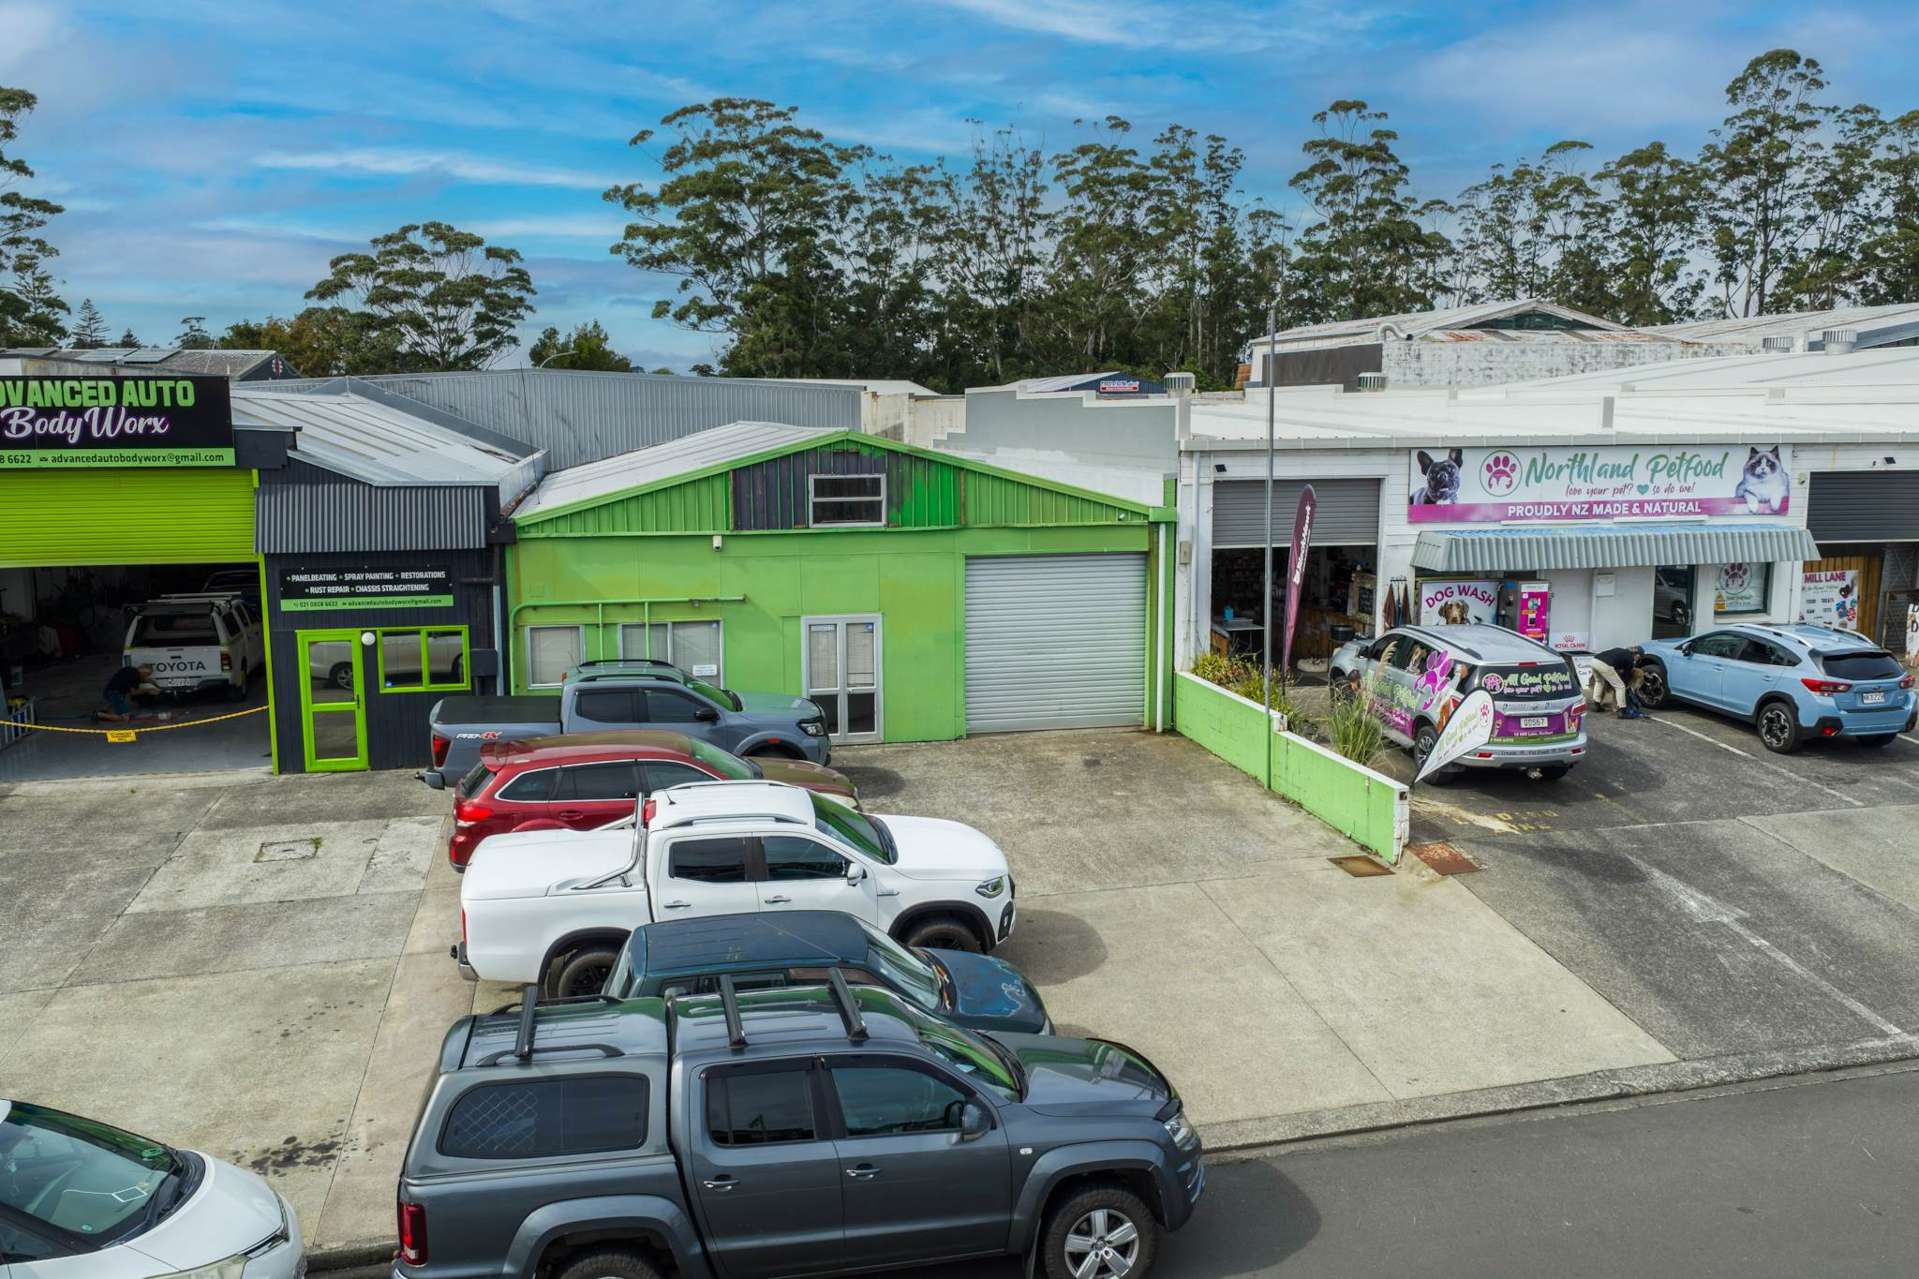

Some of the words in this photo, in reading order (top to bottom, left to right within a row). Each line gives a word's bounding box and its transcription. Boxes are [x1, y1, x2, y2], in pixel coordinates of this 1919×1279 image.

[122, 380, 196, 407] AUTO
[7, 454, 32, 464] 6622
[51, 452, 224, 464] advancedautobodyworx@gmail.com
[1524, 451, 1639, 489] Northland
[1565, 484, 1583, 497] love
[1586, 486, 1608, 498] your
[1612, 483, 1634, 497] pet?
[1664, 482, 1675, 494] do
[1507, 504, 1569, 518] PROUDLY
[1571, 504, 1589, 516] NZ
[1592, 503, 1629, 515] MADE
[1631, 502, 1641, 514] &
[1643, 500, 1702, 514] NATURAL
[291, 573, 337, 582] PANELBEATING
[344, 573, 364, 581] SPRAY
[365, 572, 394, 580] PAINTING
[401, 571, 446, 579] RESTORATIONS
[1804, 573, 1823, 583] MILL
[1825, 571, 1846, 582] LANE
[310, 586, 326, 594] RUST
[356, 585, 381, 593] CHASSIS
[381, 583, 429, 592] STRAIGHTENING
[1425, 586, 1454, 608] DOG
[1457, 584, 1496, 607] WASH
